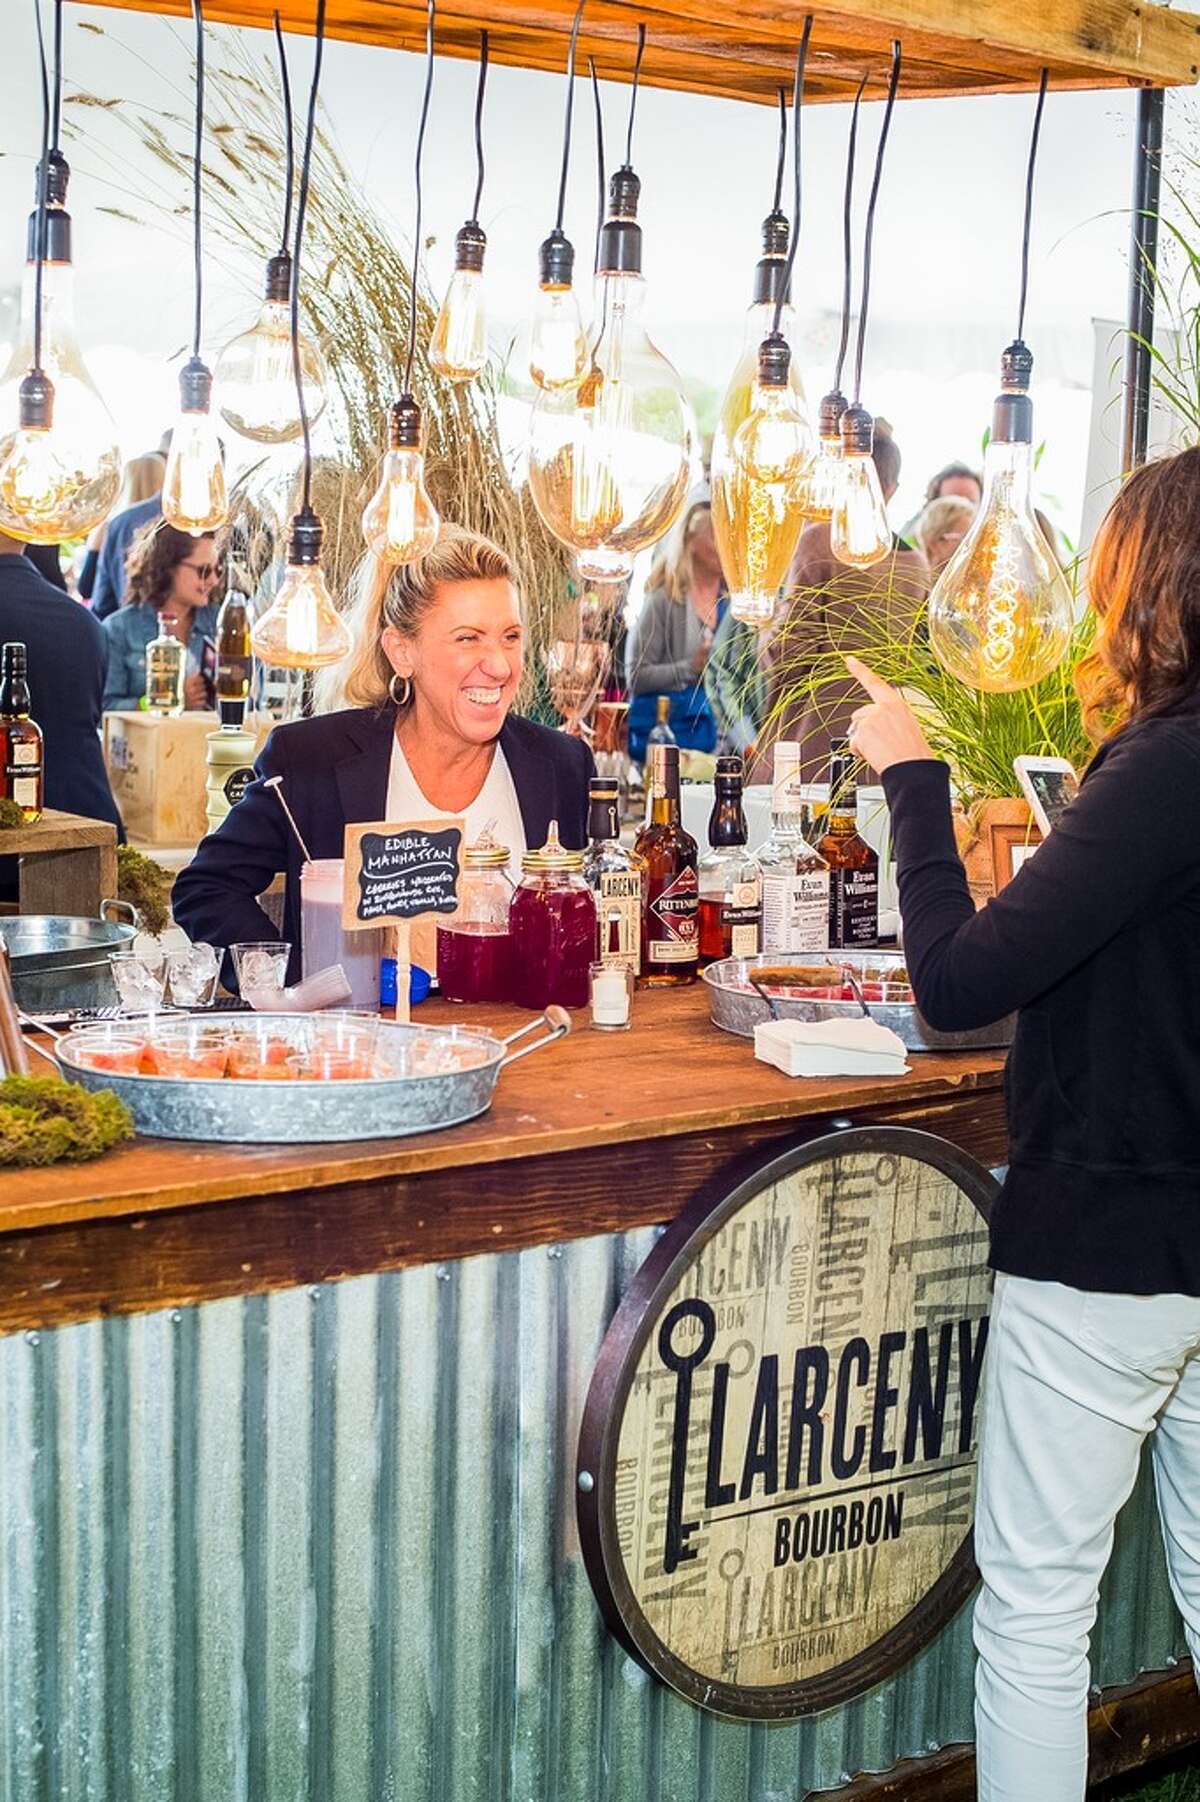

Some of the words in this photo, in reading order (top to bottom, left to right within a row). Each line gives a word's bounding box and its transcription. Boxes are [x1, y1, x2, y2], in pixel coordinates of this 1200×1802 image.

[368, 847, 452, 869] MANHATTAN
[385, 837, 430, 850] EDIBLE
[602, 878, 640, 898] LARCENY
[801, 880, 823, 890] Evan
[853, 871, 875, 882] Evan
[786, 1243, 809, 1326] BOURBON
[811, 1190, 873, 1350] LARCEN
[678, 1304, 746, 1339] BOUBON
[705, 1316, 990, 1509] LARCENY
[774, 1492, 905, 1567] BOURBON
[739, 1546, 878, 1641] LARCENY
[772, 1633, 836, 1670] BOURBON
